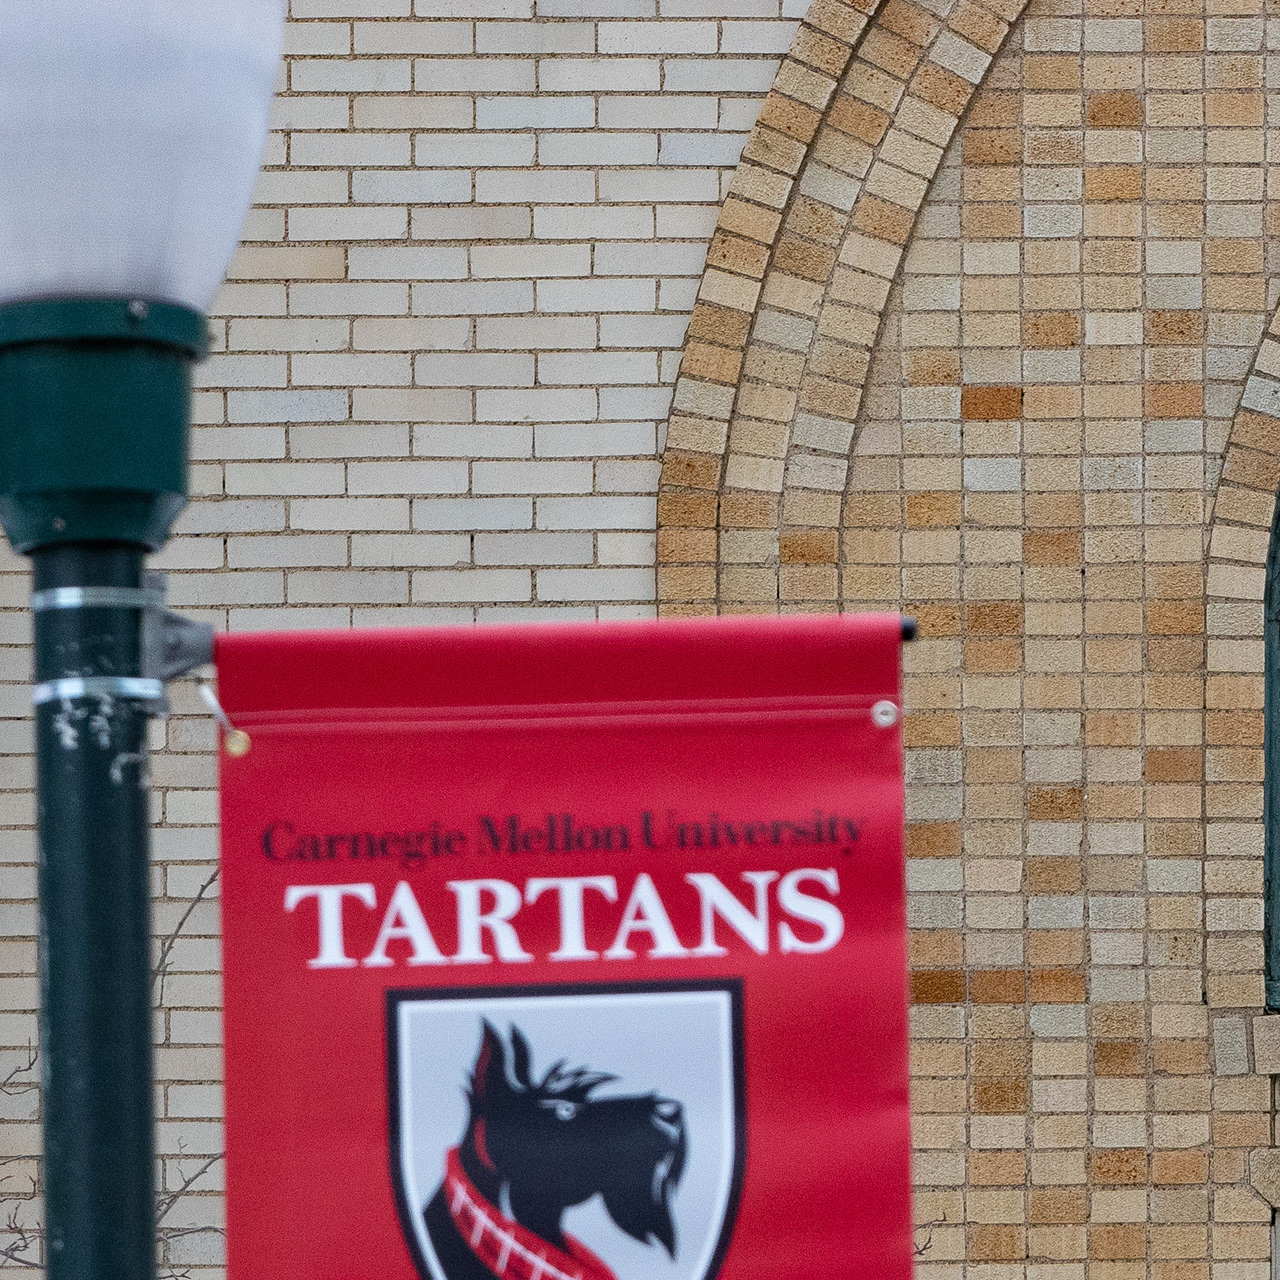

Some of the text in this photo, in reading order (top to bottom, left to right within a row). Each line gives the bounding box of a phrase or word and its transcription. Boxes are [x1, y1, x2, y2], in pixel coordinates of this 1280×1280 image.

[260, 806, 870, 870] Carnegie Mellon University
[284, 867, 845, 970] TARTANS
